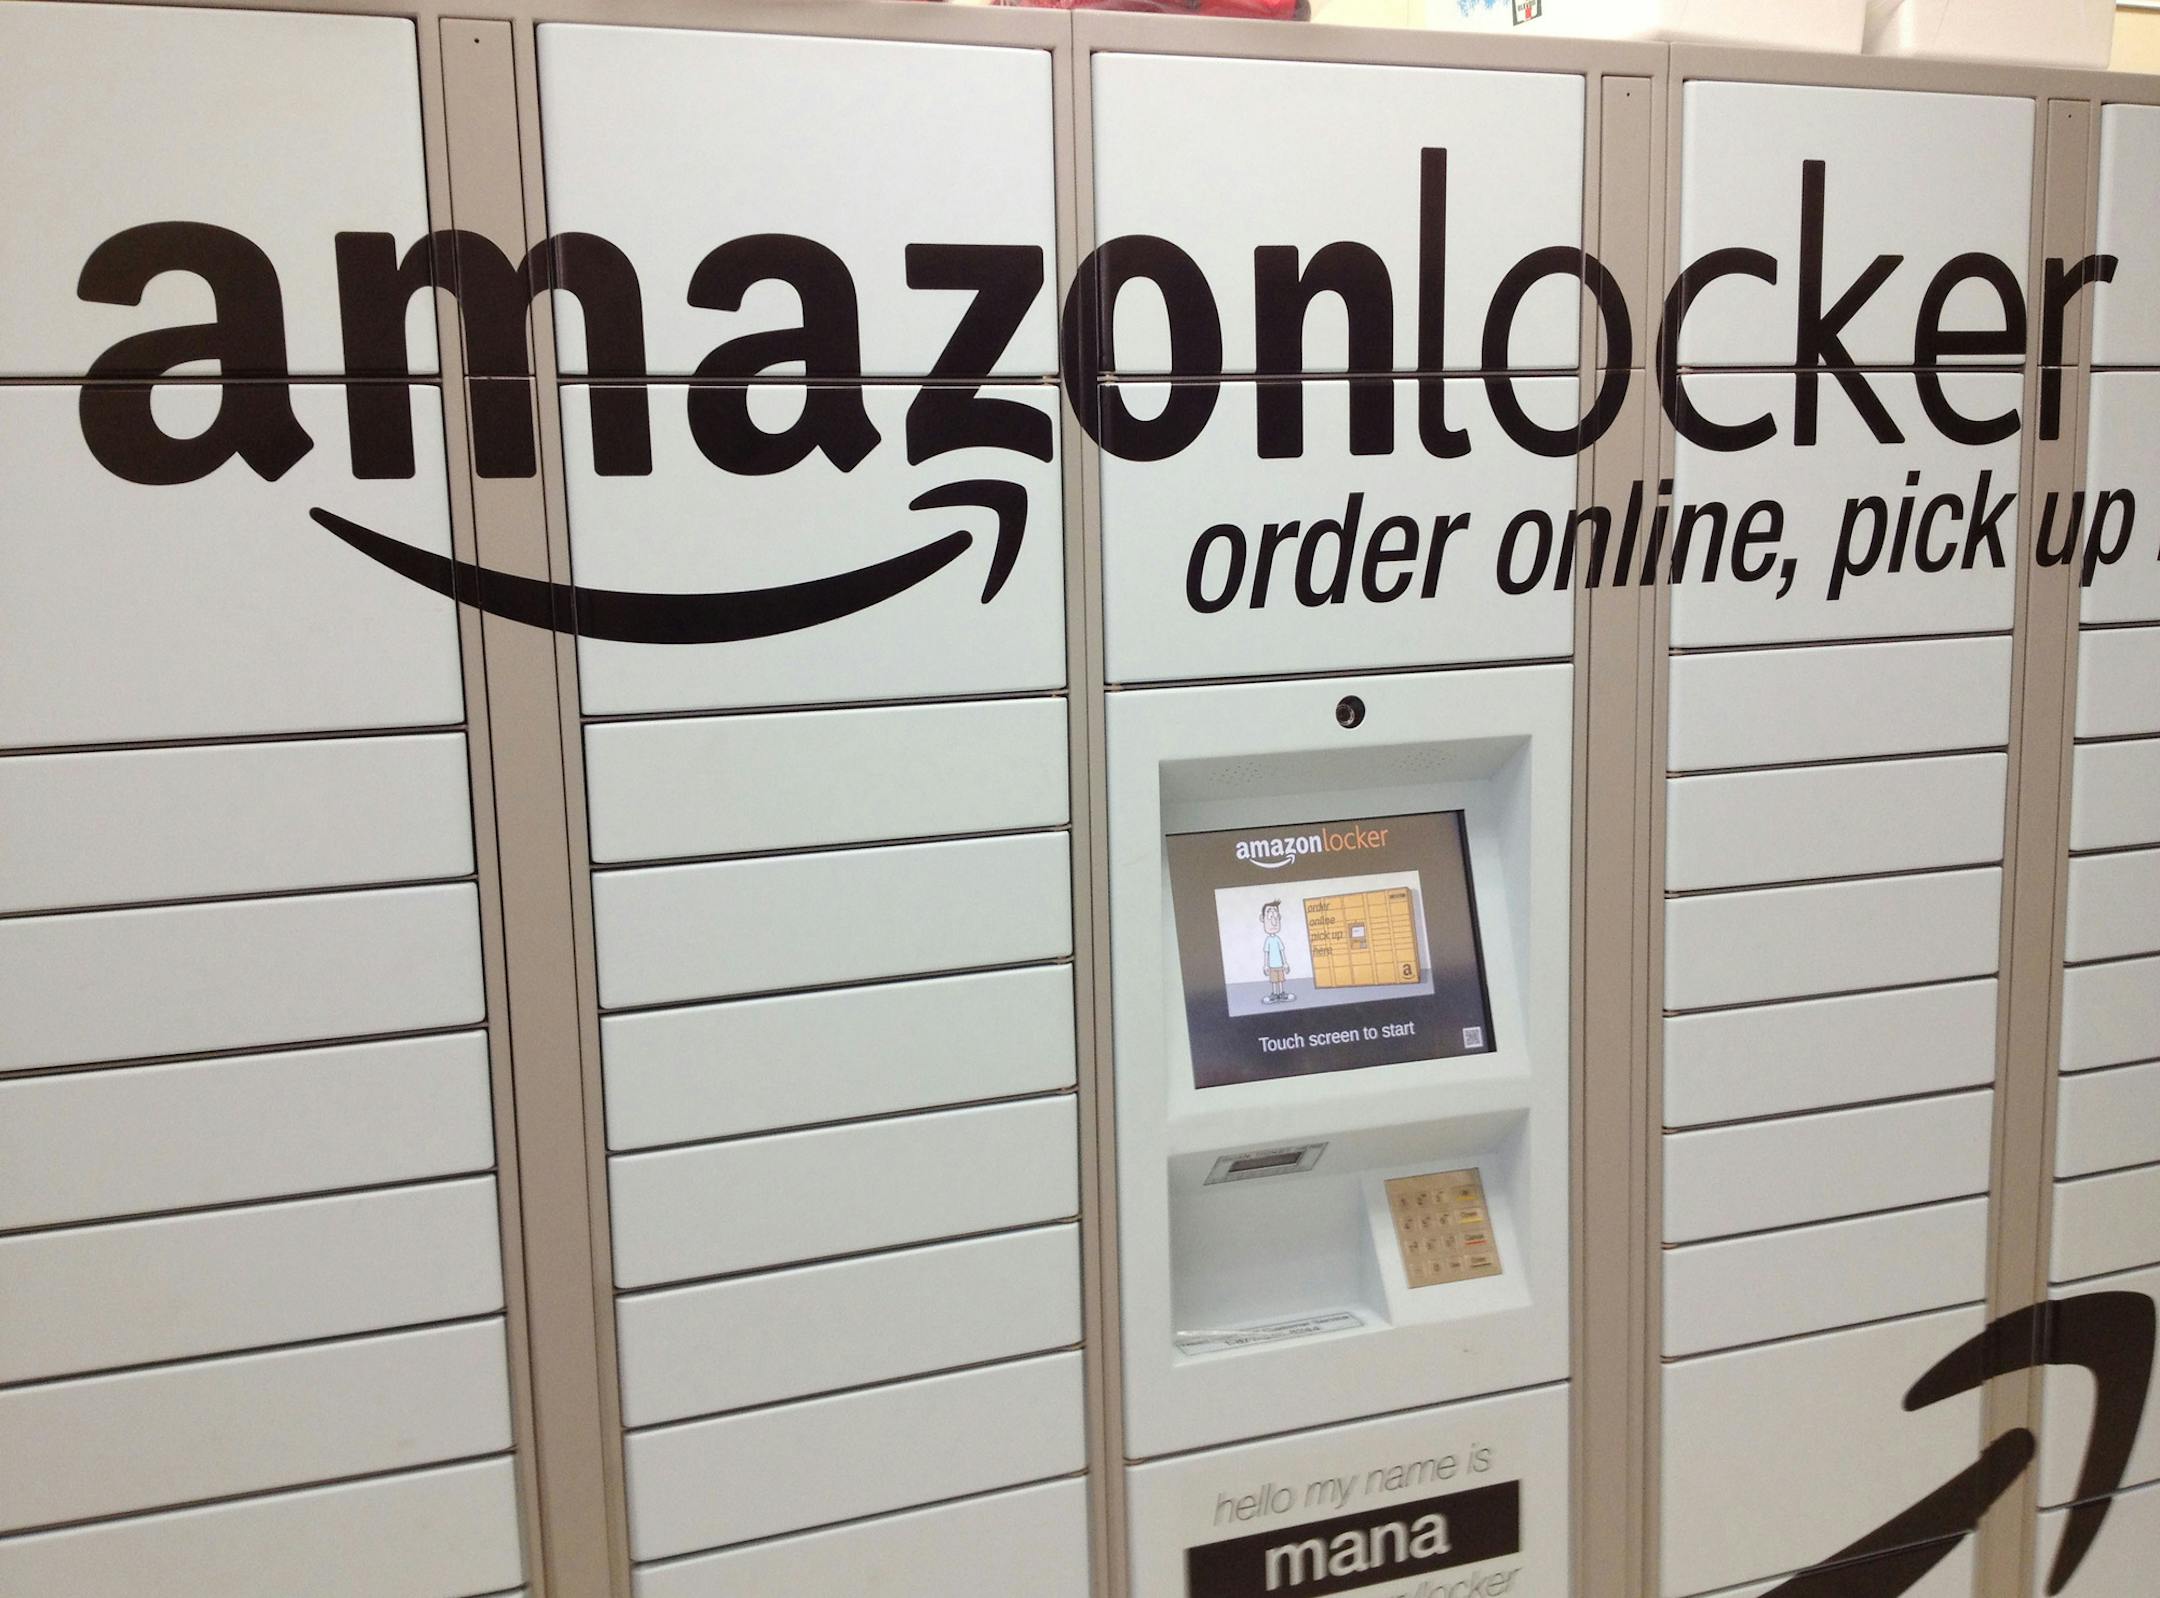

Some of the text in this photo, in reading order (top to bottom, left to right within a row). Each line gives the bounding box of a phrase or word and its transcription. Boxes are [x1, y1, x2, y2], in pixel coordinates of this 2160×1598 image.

[77, 148, 2118, 485] amazonlocker
[1187, 493, 1471, 614] order
[1497, 479, 1798, 601] online,
[1826, 470, 2017, 601] pick
[2036, 489, 2136, 587] up
[1235, 824, 1389, 860] amazonlocker
[1258, 1020, 1416, 1053] Touch screen to start
[1212, 1442, 1493, 1526] hello my name is
[1265, 1513, 1452, 1591] mana
